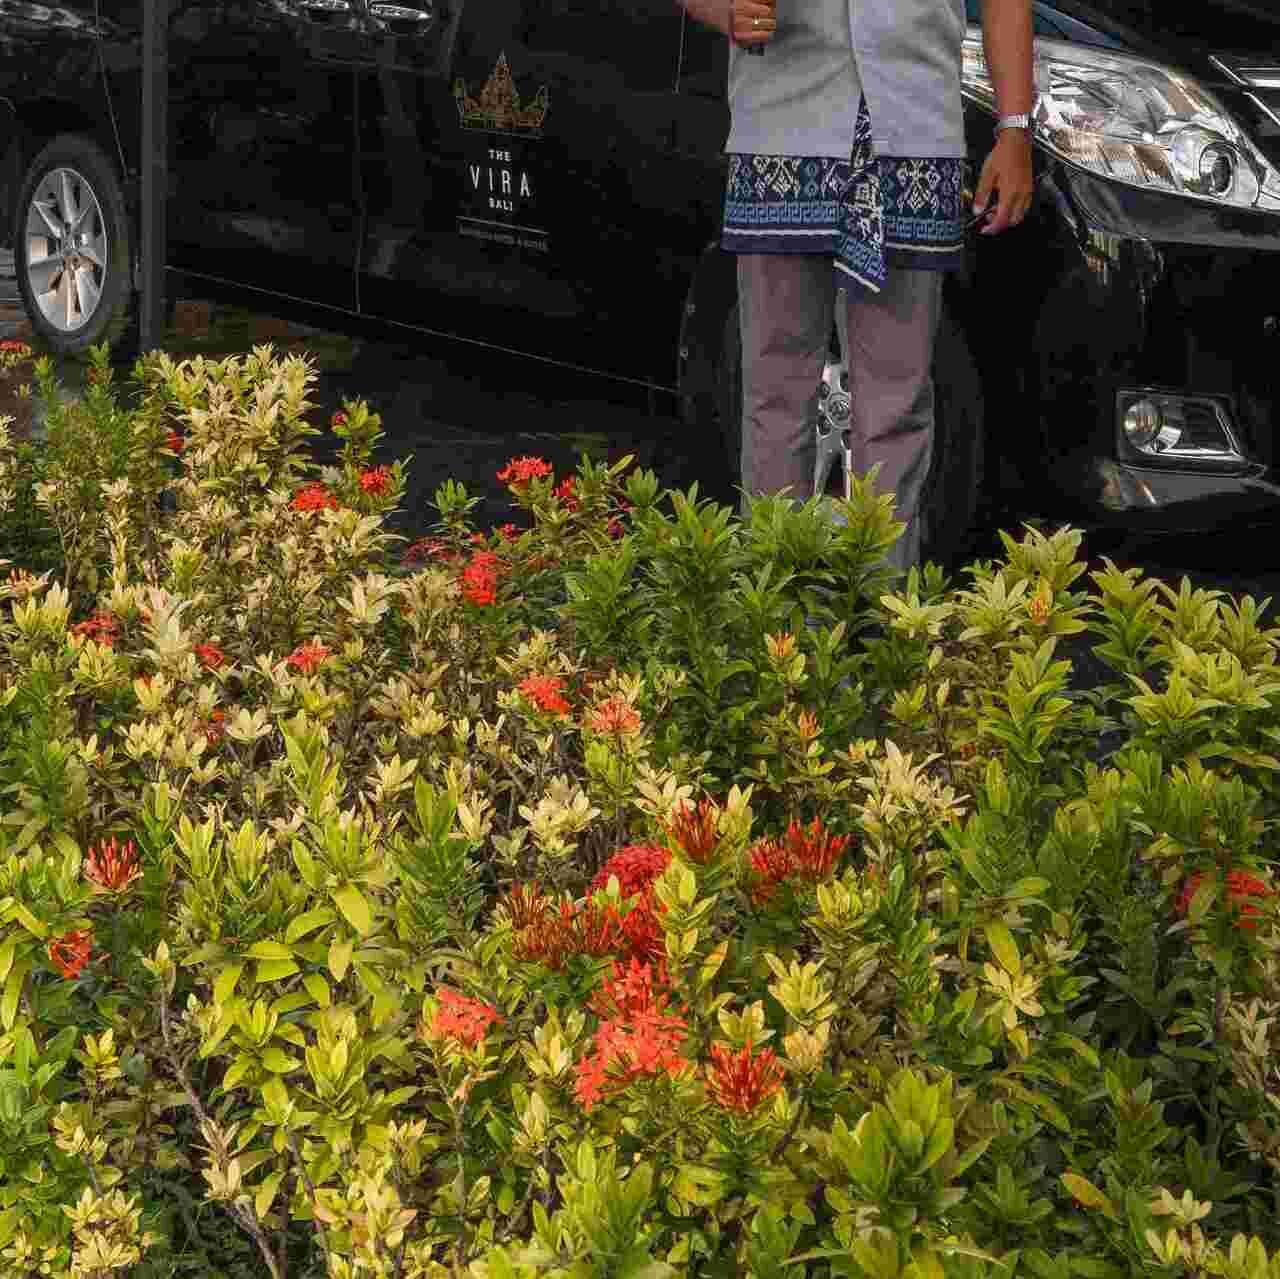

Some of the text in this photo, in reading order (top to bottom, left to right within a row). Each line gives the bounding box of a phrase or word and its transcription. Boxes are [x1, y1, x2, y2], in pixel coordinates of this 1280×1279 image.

[488, 149, 512, 162] THE
[470, 164, 531, 197] VIRA
[488, 197, 513, 211] BALI
